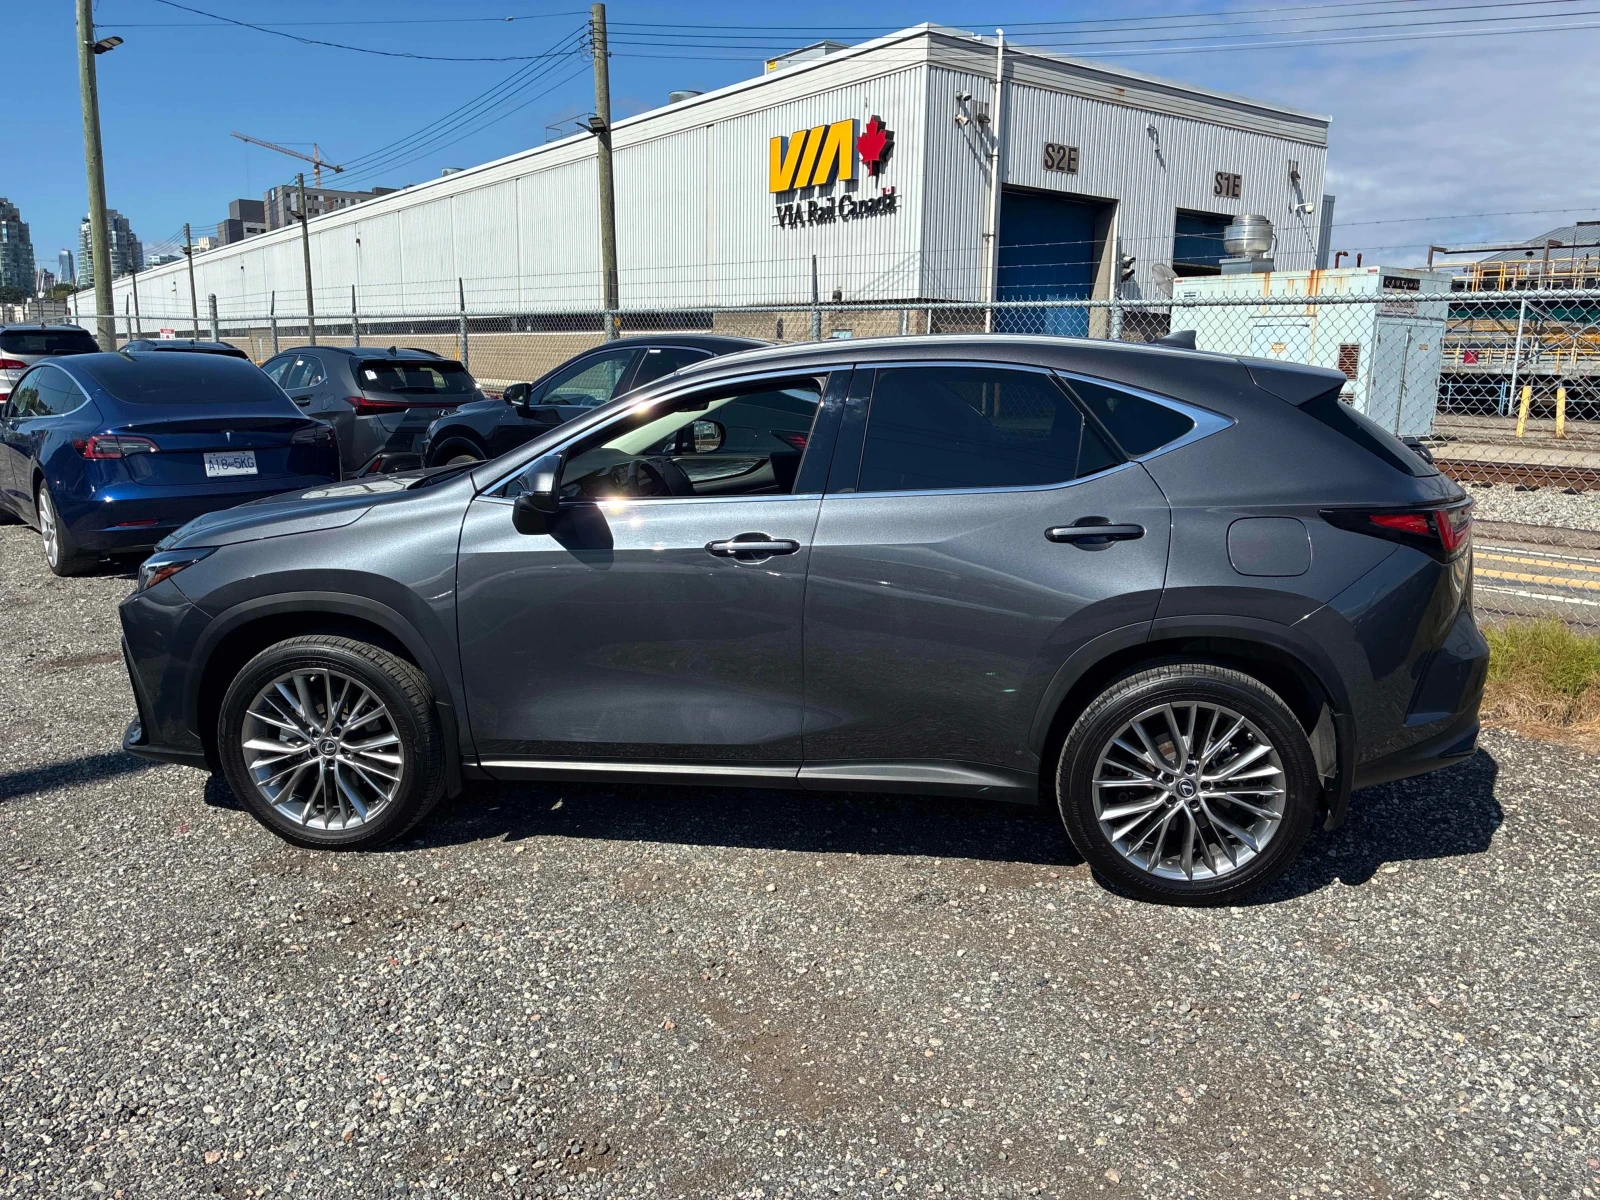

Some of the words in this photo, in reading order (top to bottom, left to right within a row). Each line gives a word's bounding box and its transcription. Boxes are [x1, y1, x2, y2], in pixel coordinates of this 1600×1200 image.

[769, 118, 857, 193] VIA
[1044, 143, 1077, 172] S2E
[1214, 172, 1241, 197] S1E
[776, 202, 805, 227] VIA
[807, 197, 836, 223] Rail
[839, 194, 897, 221] Canada
[1385, 279, 1419, 289] CAUTION
